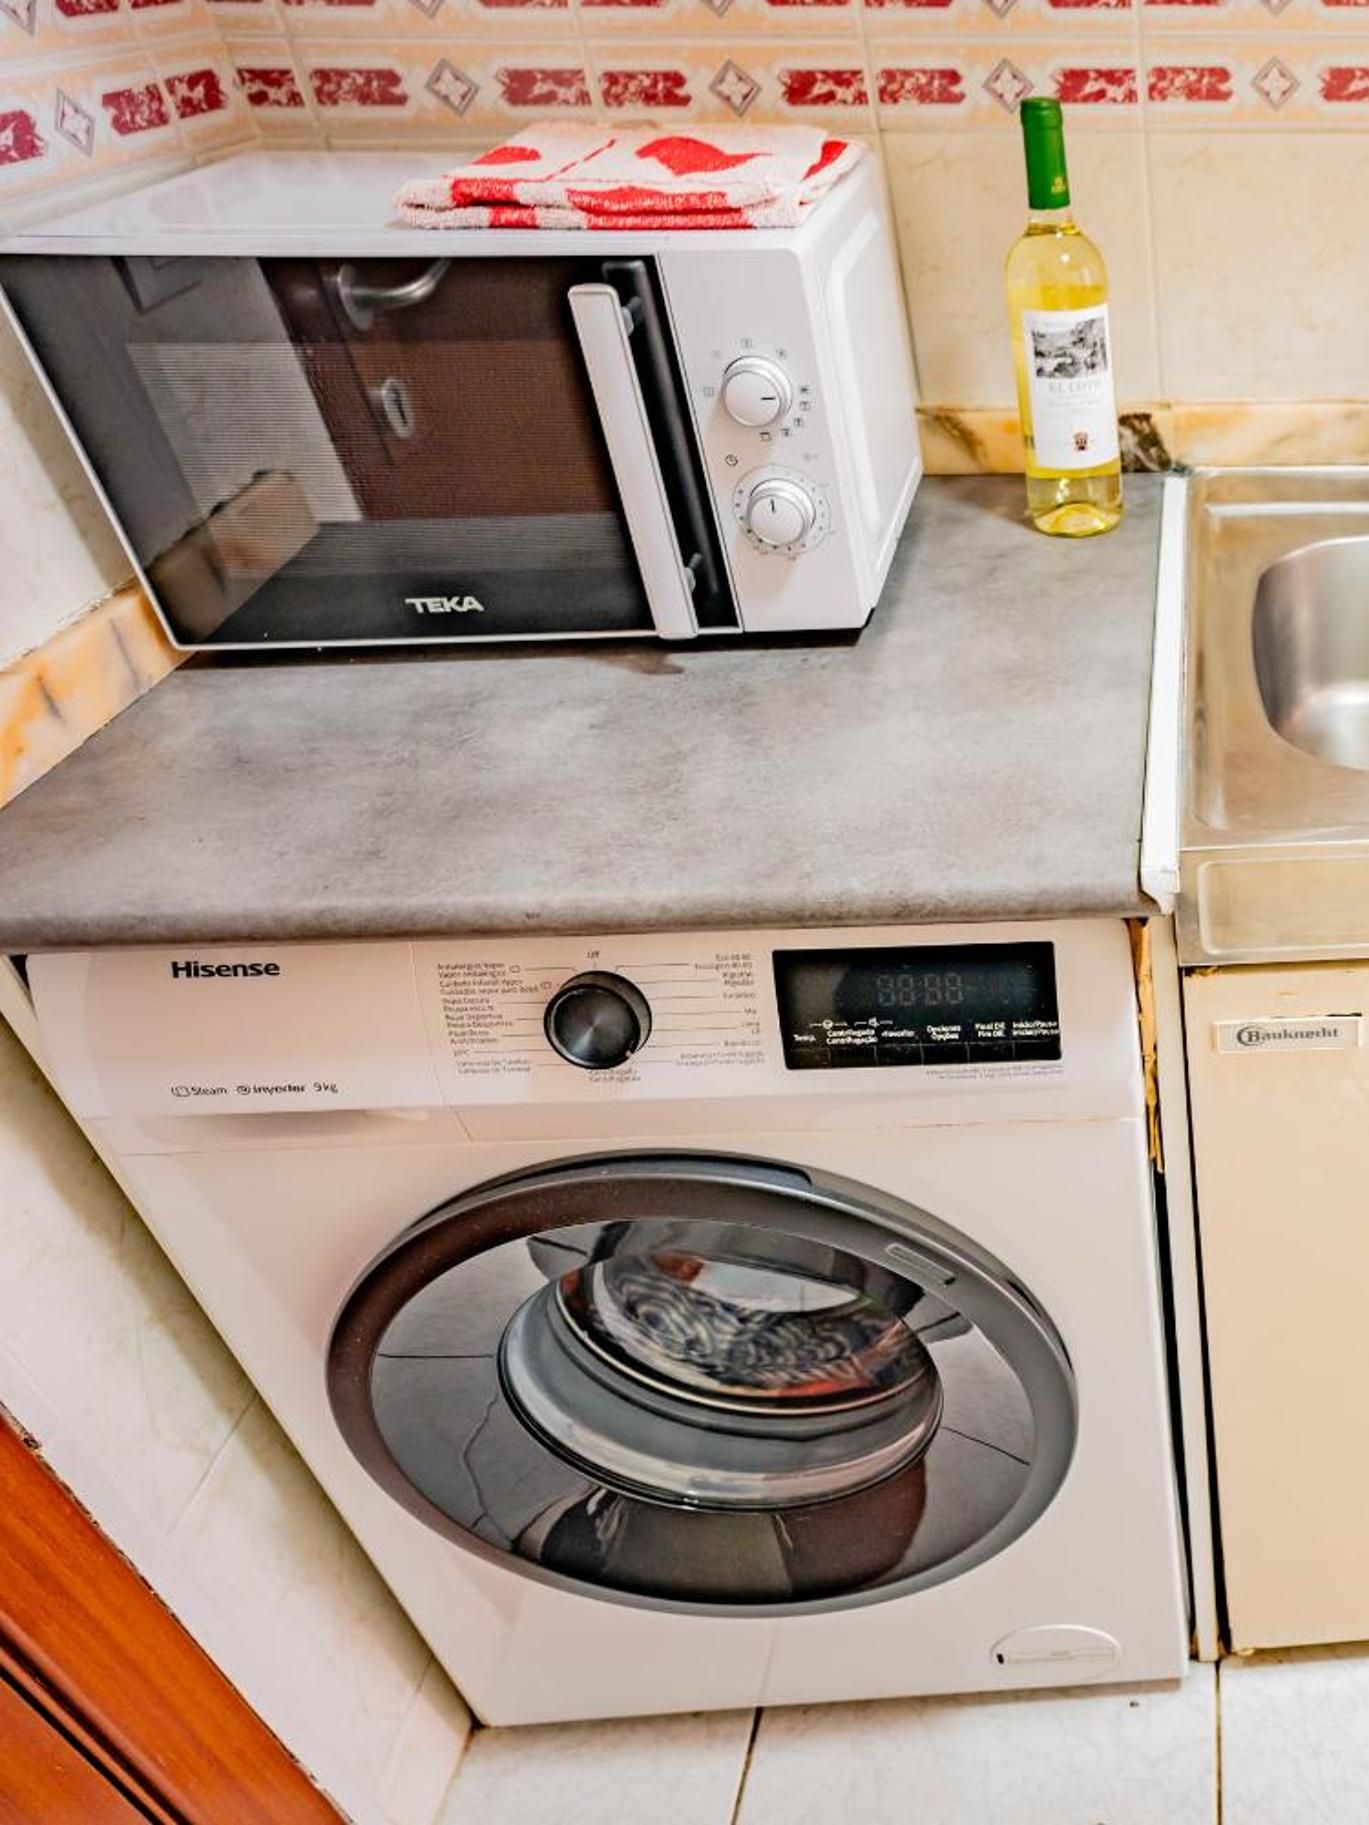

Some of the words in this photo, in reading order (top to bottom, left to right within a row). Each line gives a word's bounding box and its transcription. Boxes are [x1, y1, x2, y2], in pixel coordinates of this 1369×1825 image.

[404, 596, 484, 614] TEKA
[171, 961, 280, 978] Hisense
[1245, 1027, 1339, 1044] Bauknecht
[191, 1085, 228, 1096] Steam
